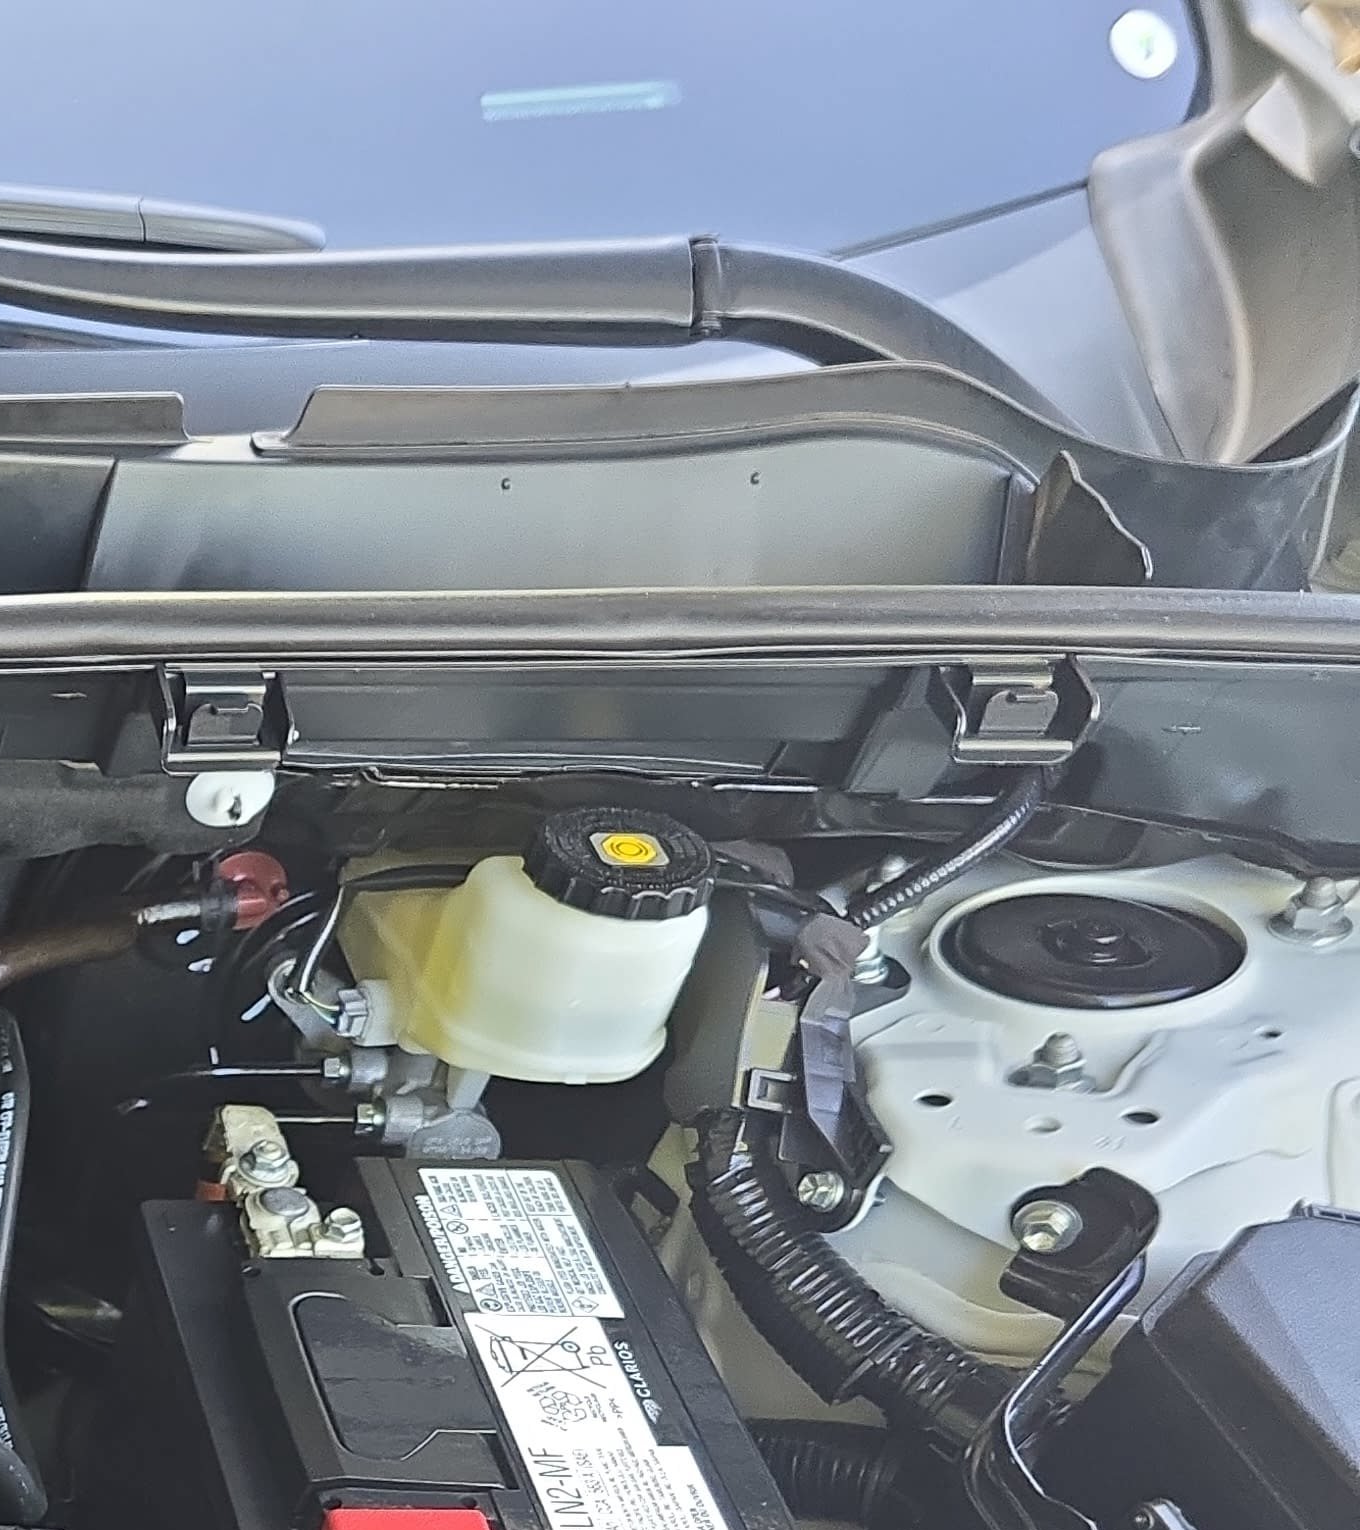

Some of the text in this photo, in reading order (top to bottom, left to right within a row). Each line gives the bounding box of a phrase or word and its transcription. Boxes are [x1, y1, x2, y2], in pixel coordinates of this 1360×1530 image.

[414, 1194, 467, 1284] DANGER/POISON
[586, 1345, 613, 1367] Pb
[613, 1339, 652, 1399] CLARIOS
